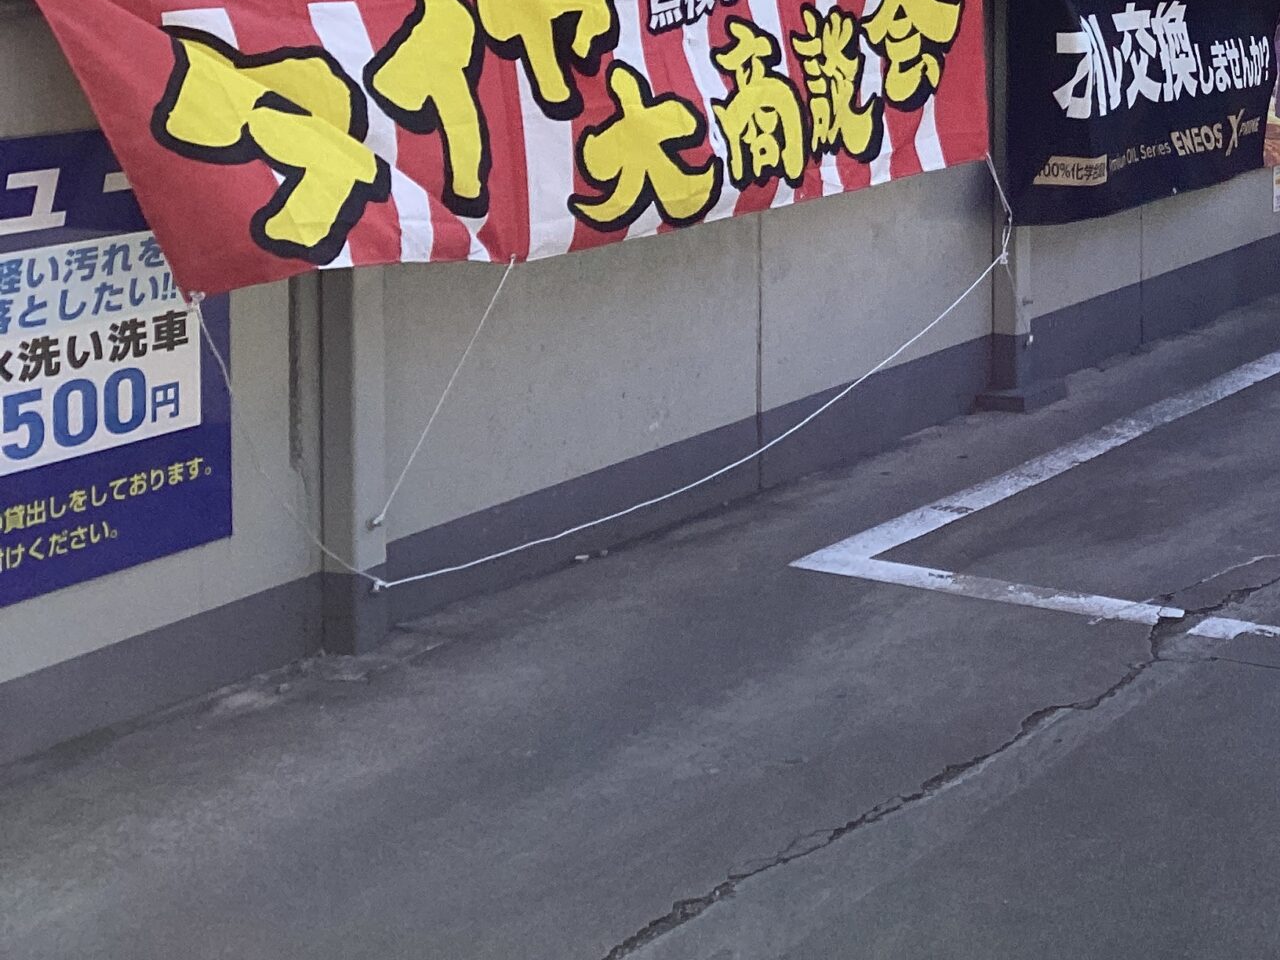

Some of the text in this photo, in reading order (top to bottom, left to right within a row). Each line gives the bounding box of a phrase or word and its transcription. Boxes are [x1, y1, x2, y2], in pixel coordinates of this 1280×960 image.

[1170, 122, 1223, 157] ENEOS
[2, 367, 181, 461] 500円
[0, 521, 118, 573] けください。
